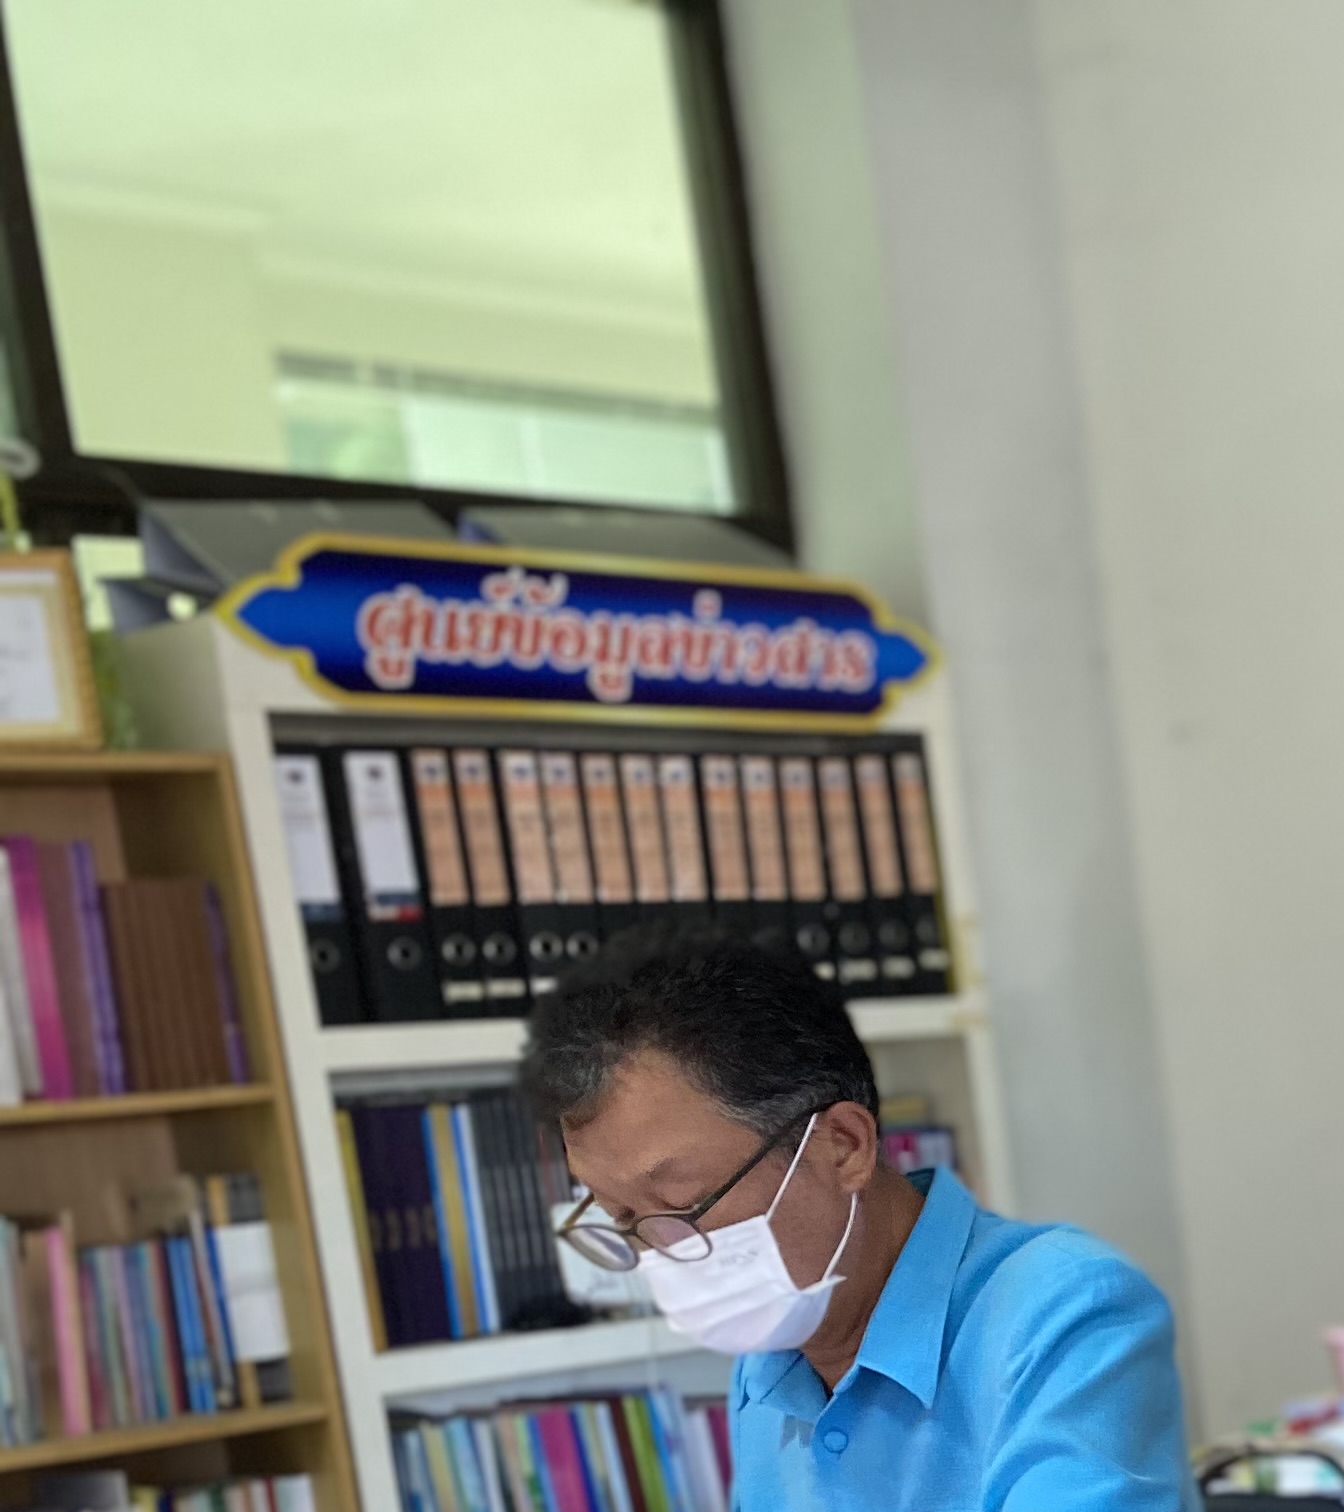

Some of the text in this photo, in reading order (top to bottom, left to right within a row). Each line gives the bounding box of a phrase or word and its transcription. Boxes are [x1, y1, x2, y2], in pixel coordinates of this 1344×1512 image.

[356, 566, 877, 702] ศูนย์ข้อมูลข่าวสาร
